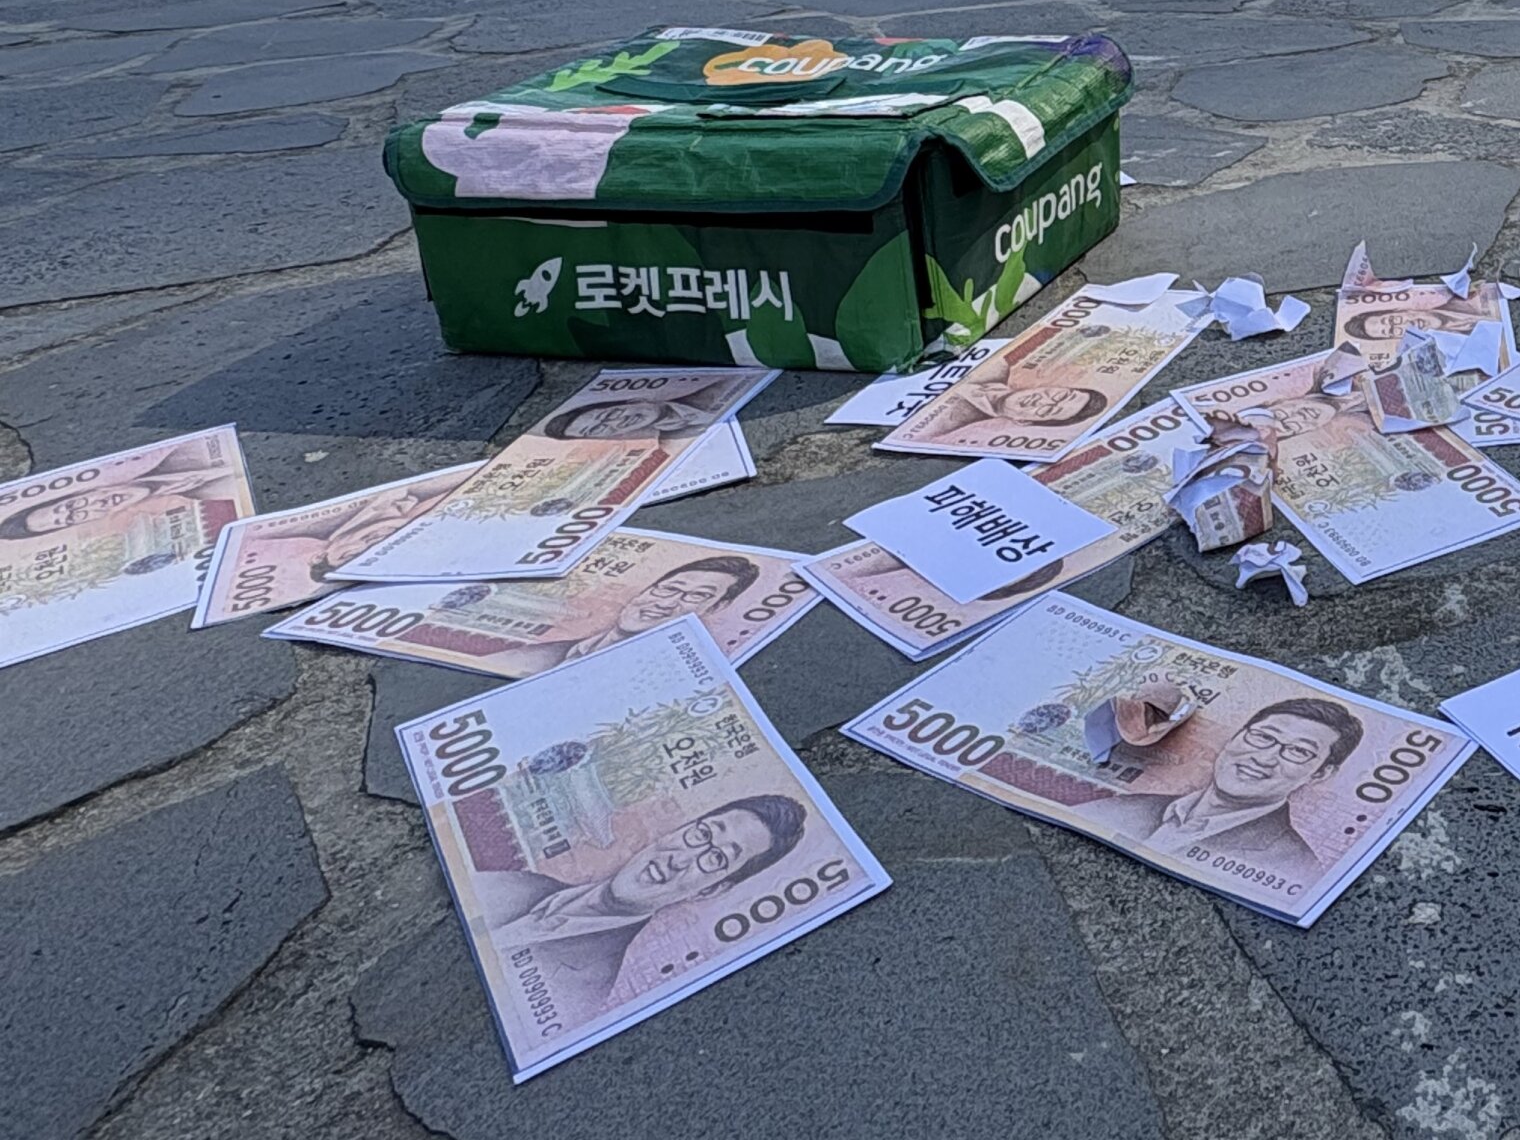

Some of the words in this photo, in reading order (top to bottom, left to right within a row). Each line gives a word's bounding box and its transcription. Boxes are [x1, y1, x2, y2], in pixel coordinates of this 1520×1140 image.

[738, 51, 948, 77] coupang
[995, 162, 1103, 263] coupang
[575, 264, 793, 321] 로켓프레시
[589, 376, 670, 391] 5000
[988, 434, 1068, 451] 5000
[0, 467, 101, 506] 5000
[514, 505, 614, 566] 5000
[924, 484, 1056, 563] 피해배상
[232, 564, 277, 613] 5000
[304, 601, 424, 637] 5000
[888, 595, 962, 638] 5000
[1172, 652, 1239, 679] 한국은행
[429, 708, 507, 797] 5000
[883, 698, 1006, 767] 5000
[662, 736, 718, 790] 오천원
[1355, 728, 1443, 804] 5000
[1186, 845, 1211, 863] BD
[1212, 855, 1286, 891] 0090993
[1286, 883, 1304, 897] C
[713, 859, 851, 943] 5000
[510, 947, 530, 970] BD
[518, 967, 557, 1028] 0090993
[540, 1023, 562, 1038] C
